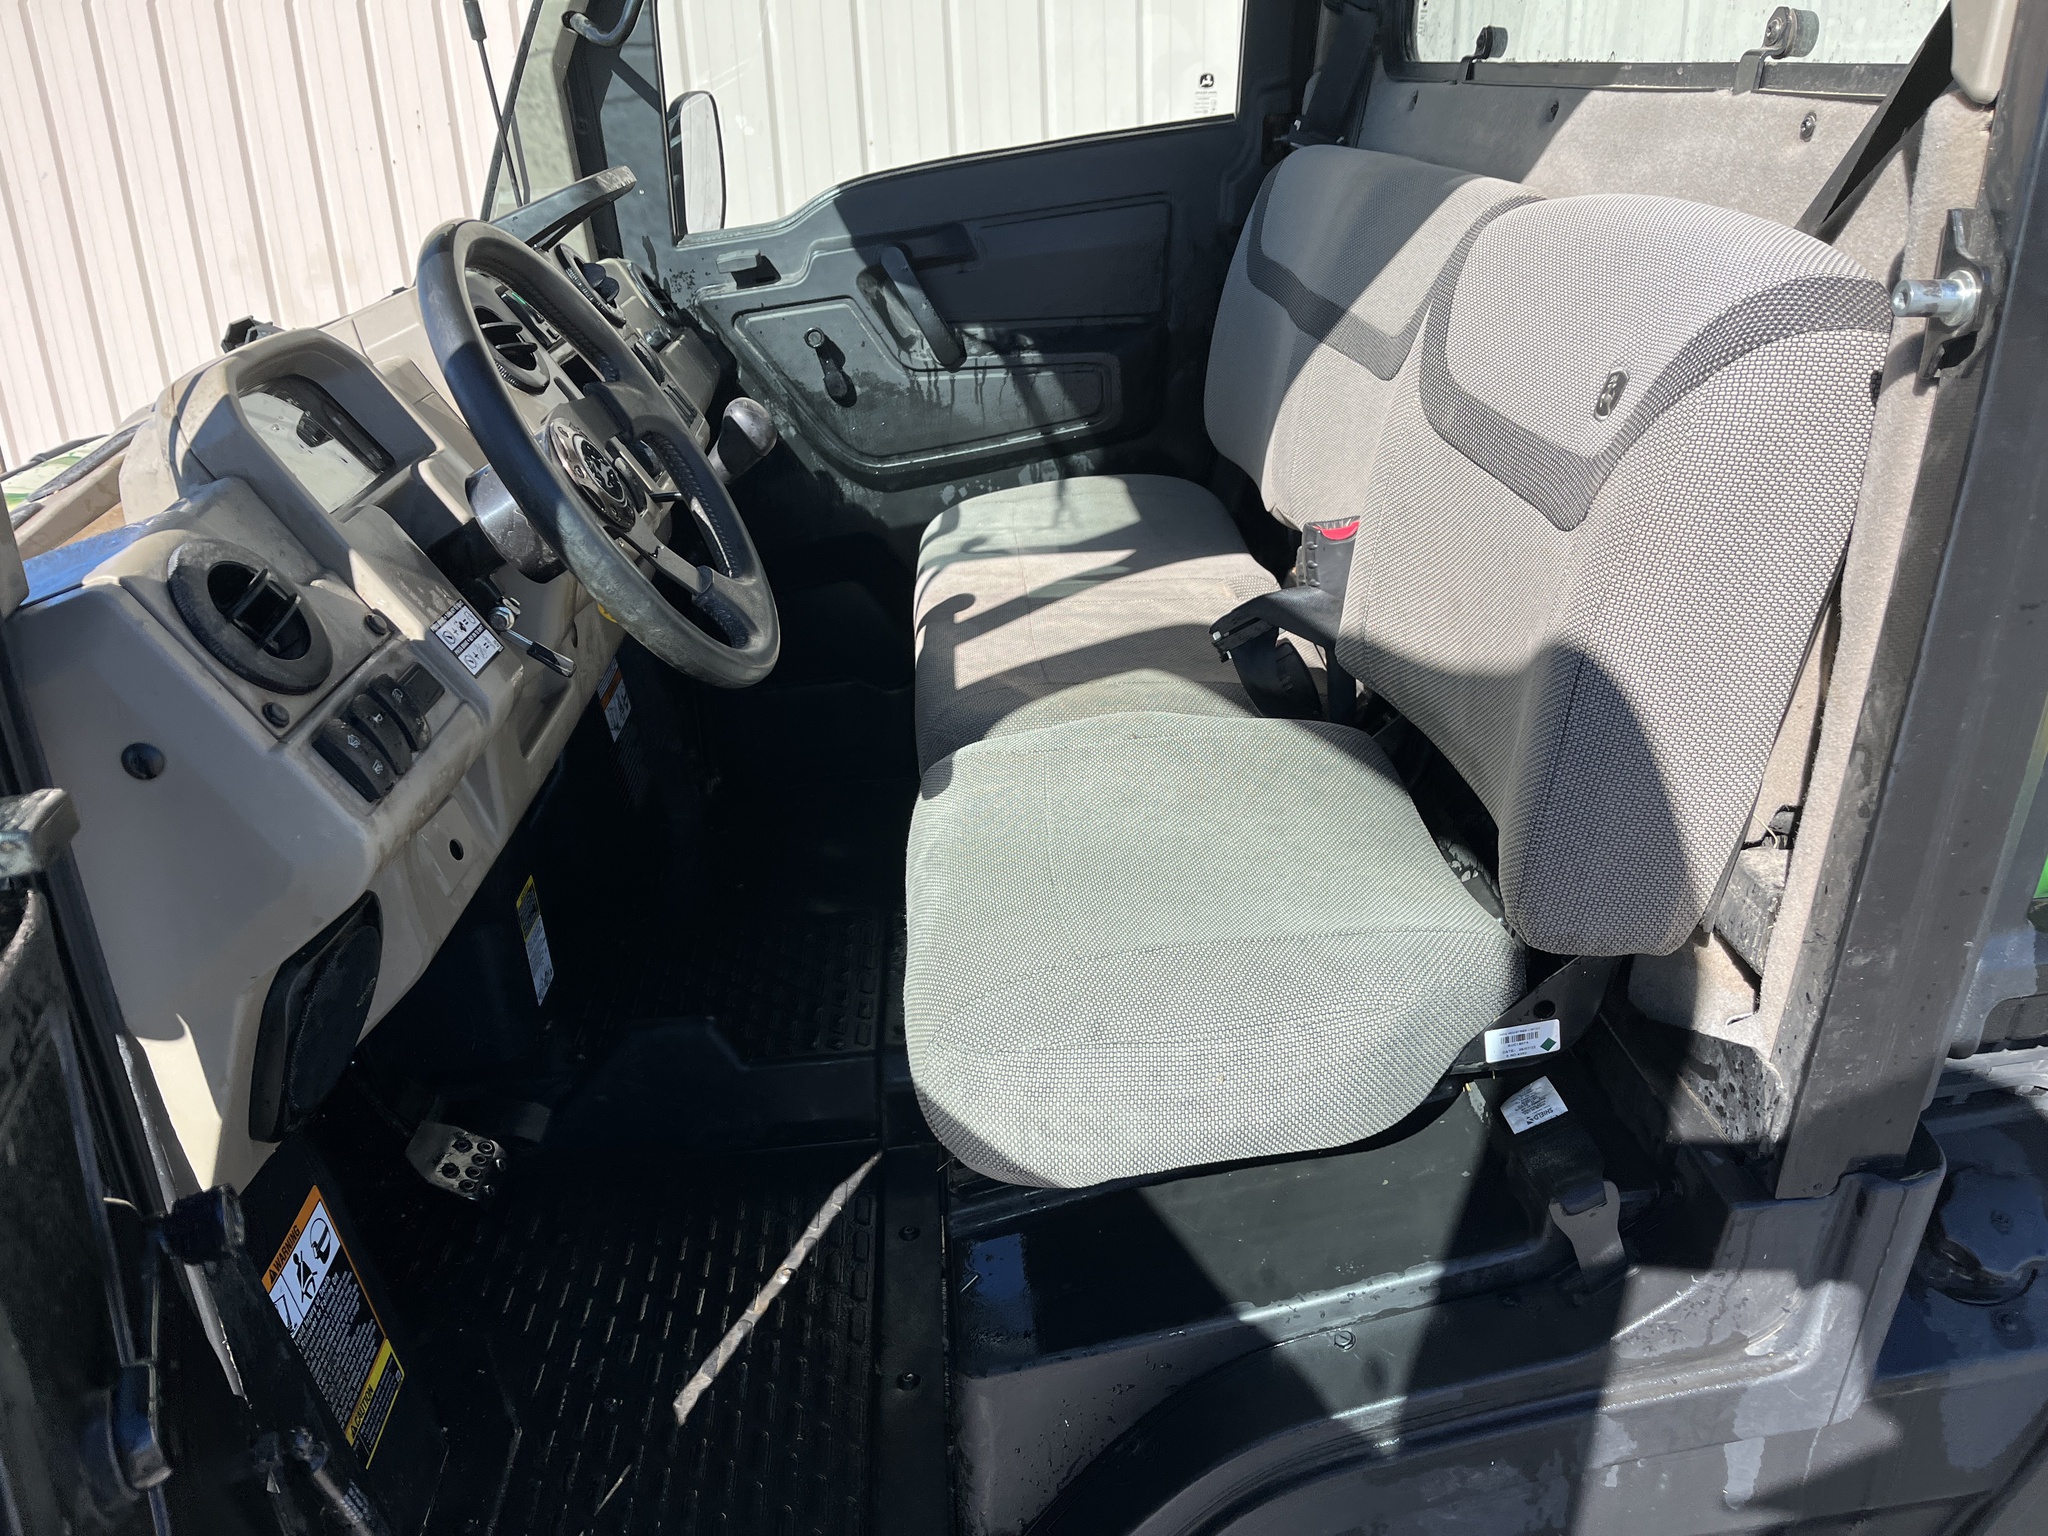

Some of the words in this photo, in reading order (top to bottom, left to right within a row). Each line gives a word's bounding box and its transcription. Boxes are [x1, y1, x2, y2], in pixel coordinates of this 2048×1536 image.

[1534, 1108, 1554, 1121] SHIELD
[273, 1225, 300, 1272] WARNING
[354, 1386, 374, 1426] CAUTION
